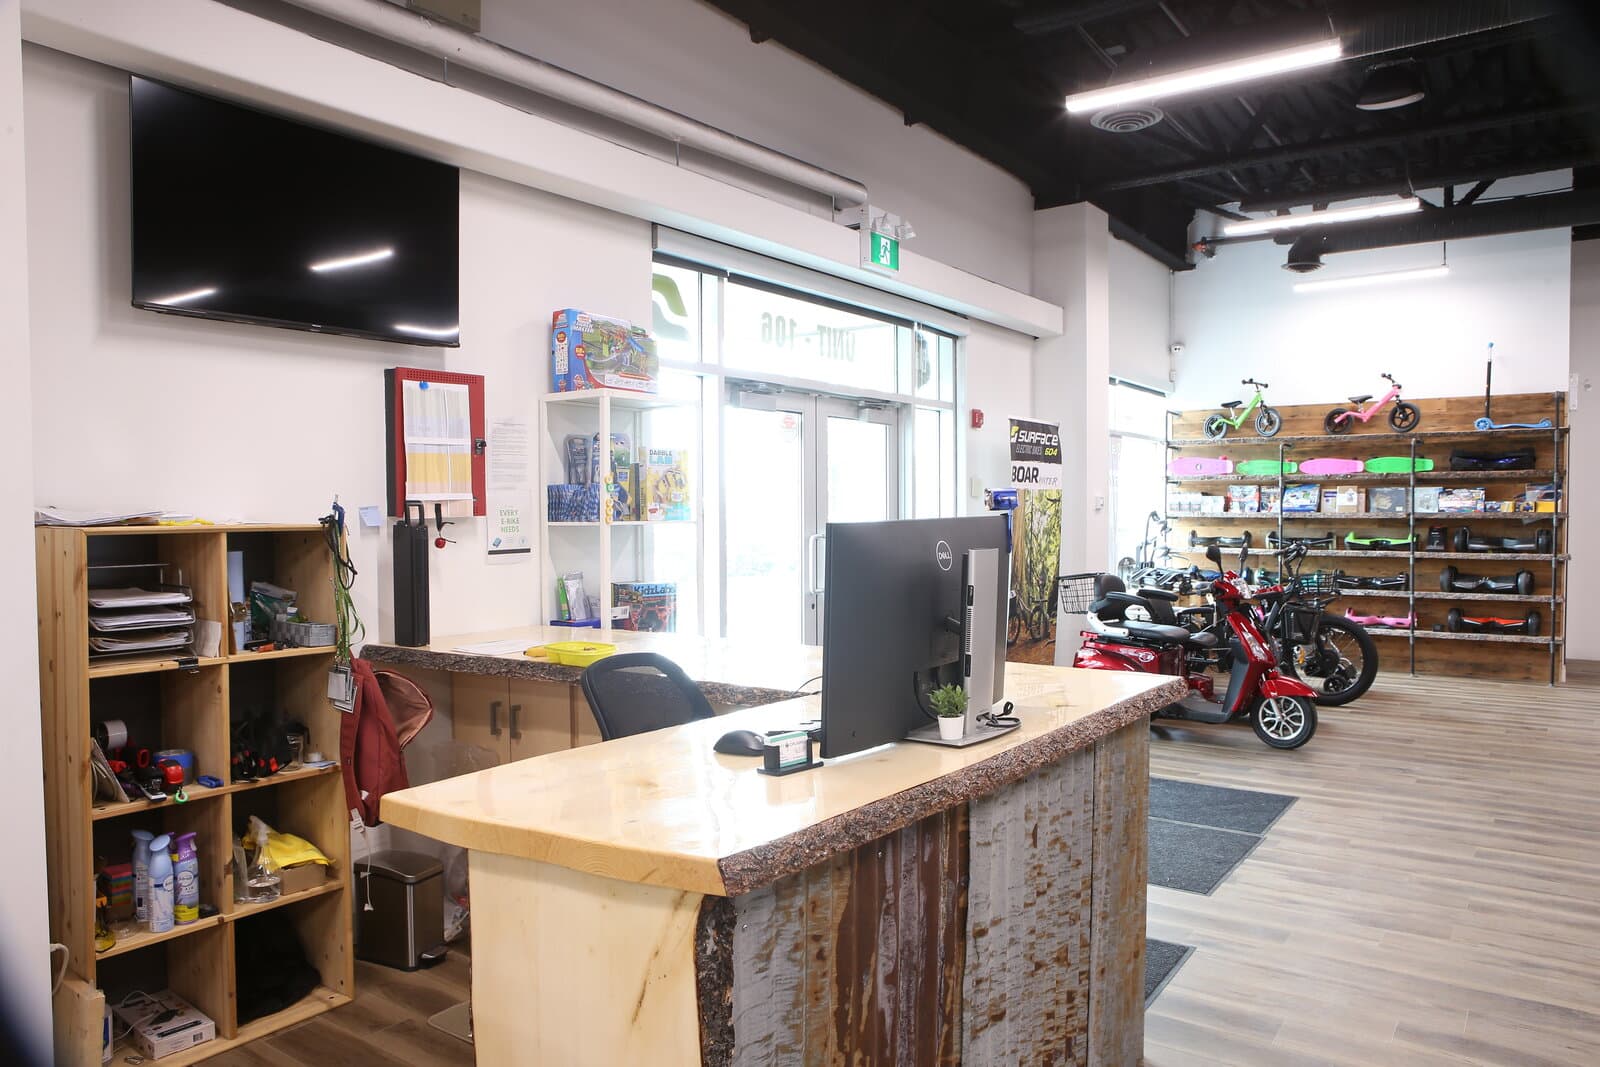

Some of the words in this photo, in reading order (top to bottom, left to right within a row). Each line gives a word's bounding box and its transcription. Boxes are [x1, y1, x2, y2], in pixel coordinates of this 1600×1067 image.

[1044, 447, 1058, 456] 604
[1011, 465, 1039, 483] BOAR
[938, 552, 952, 560] DELL
